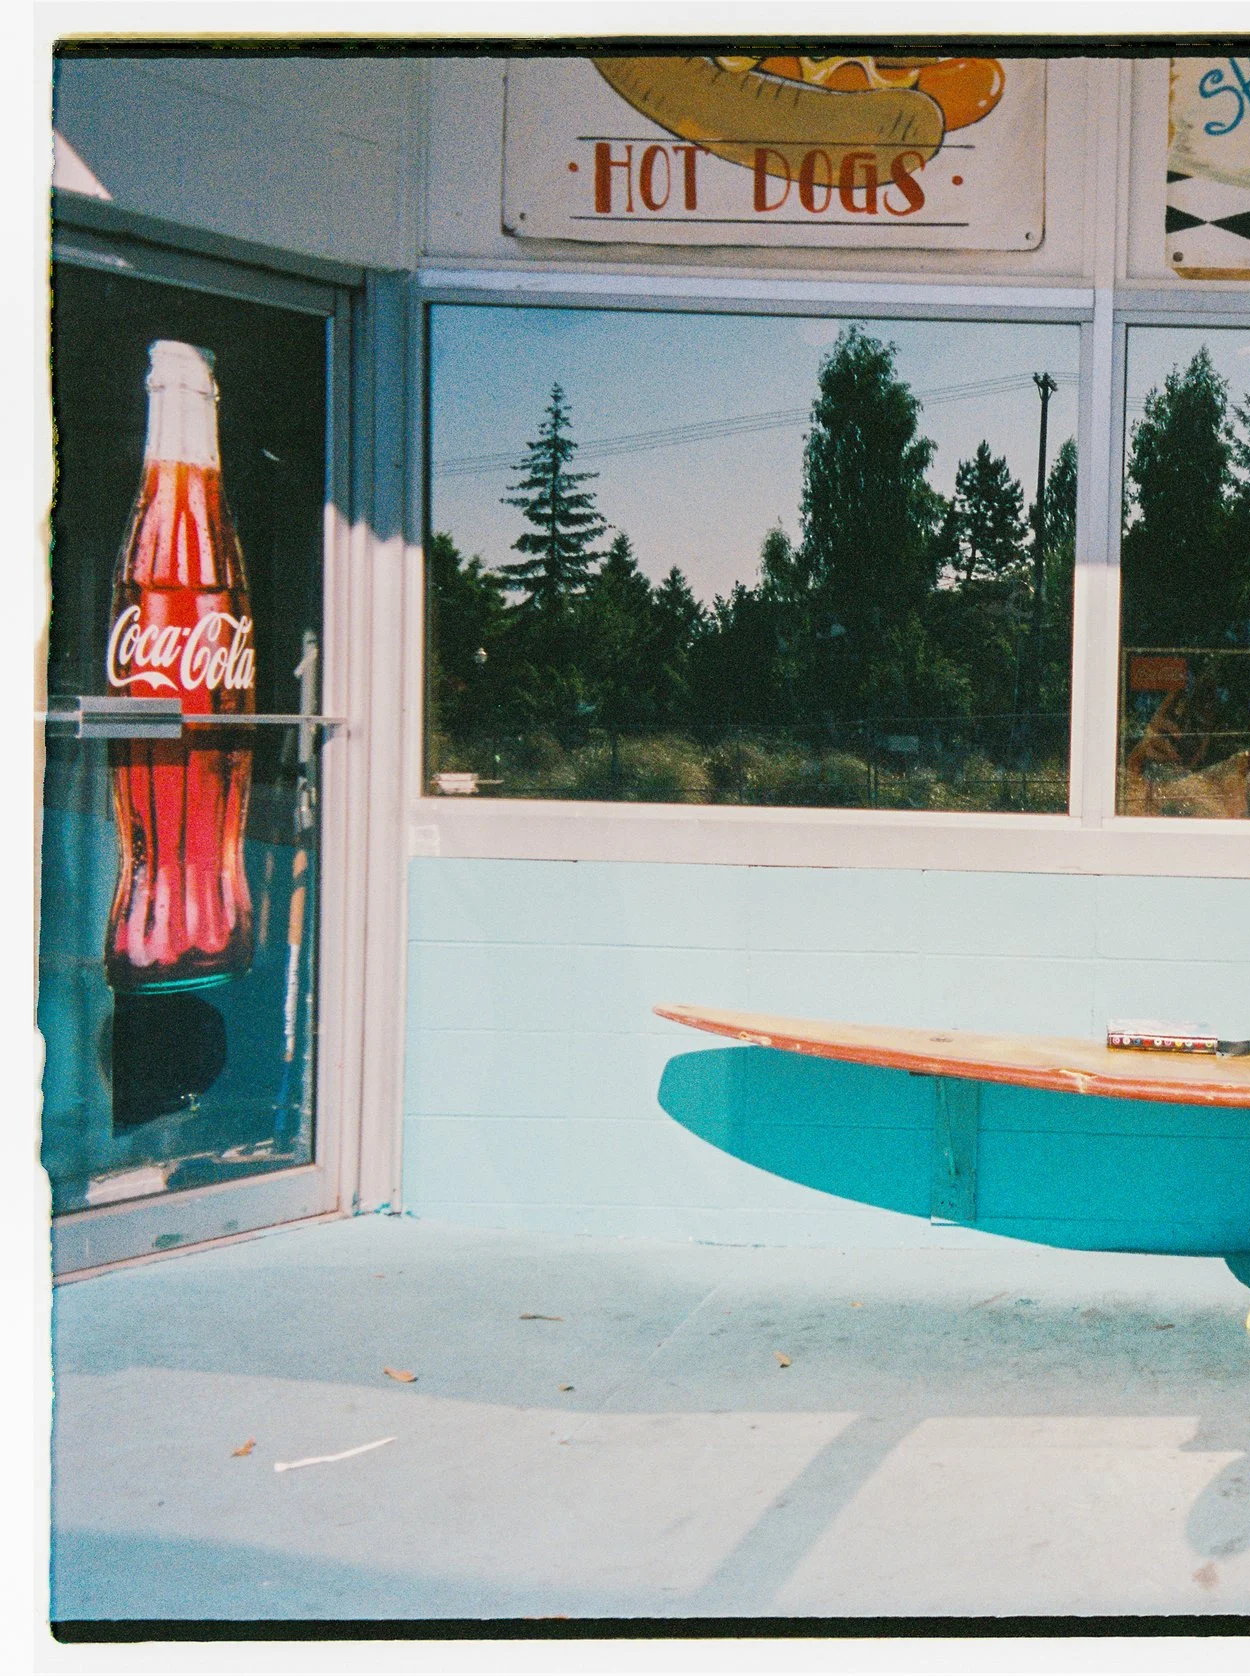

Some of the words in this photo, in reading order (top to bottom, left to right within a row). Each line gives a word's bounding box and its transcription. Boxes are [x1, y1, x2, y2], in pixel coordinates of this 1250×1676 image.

[594, 142, 711, 214] HOT
[752, 147, 926, 216] DOGS
[107, 605, 256, 691] Coca-Cola
